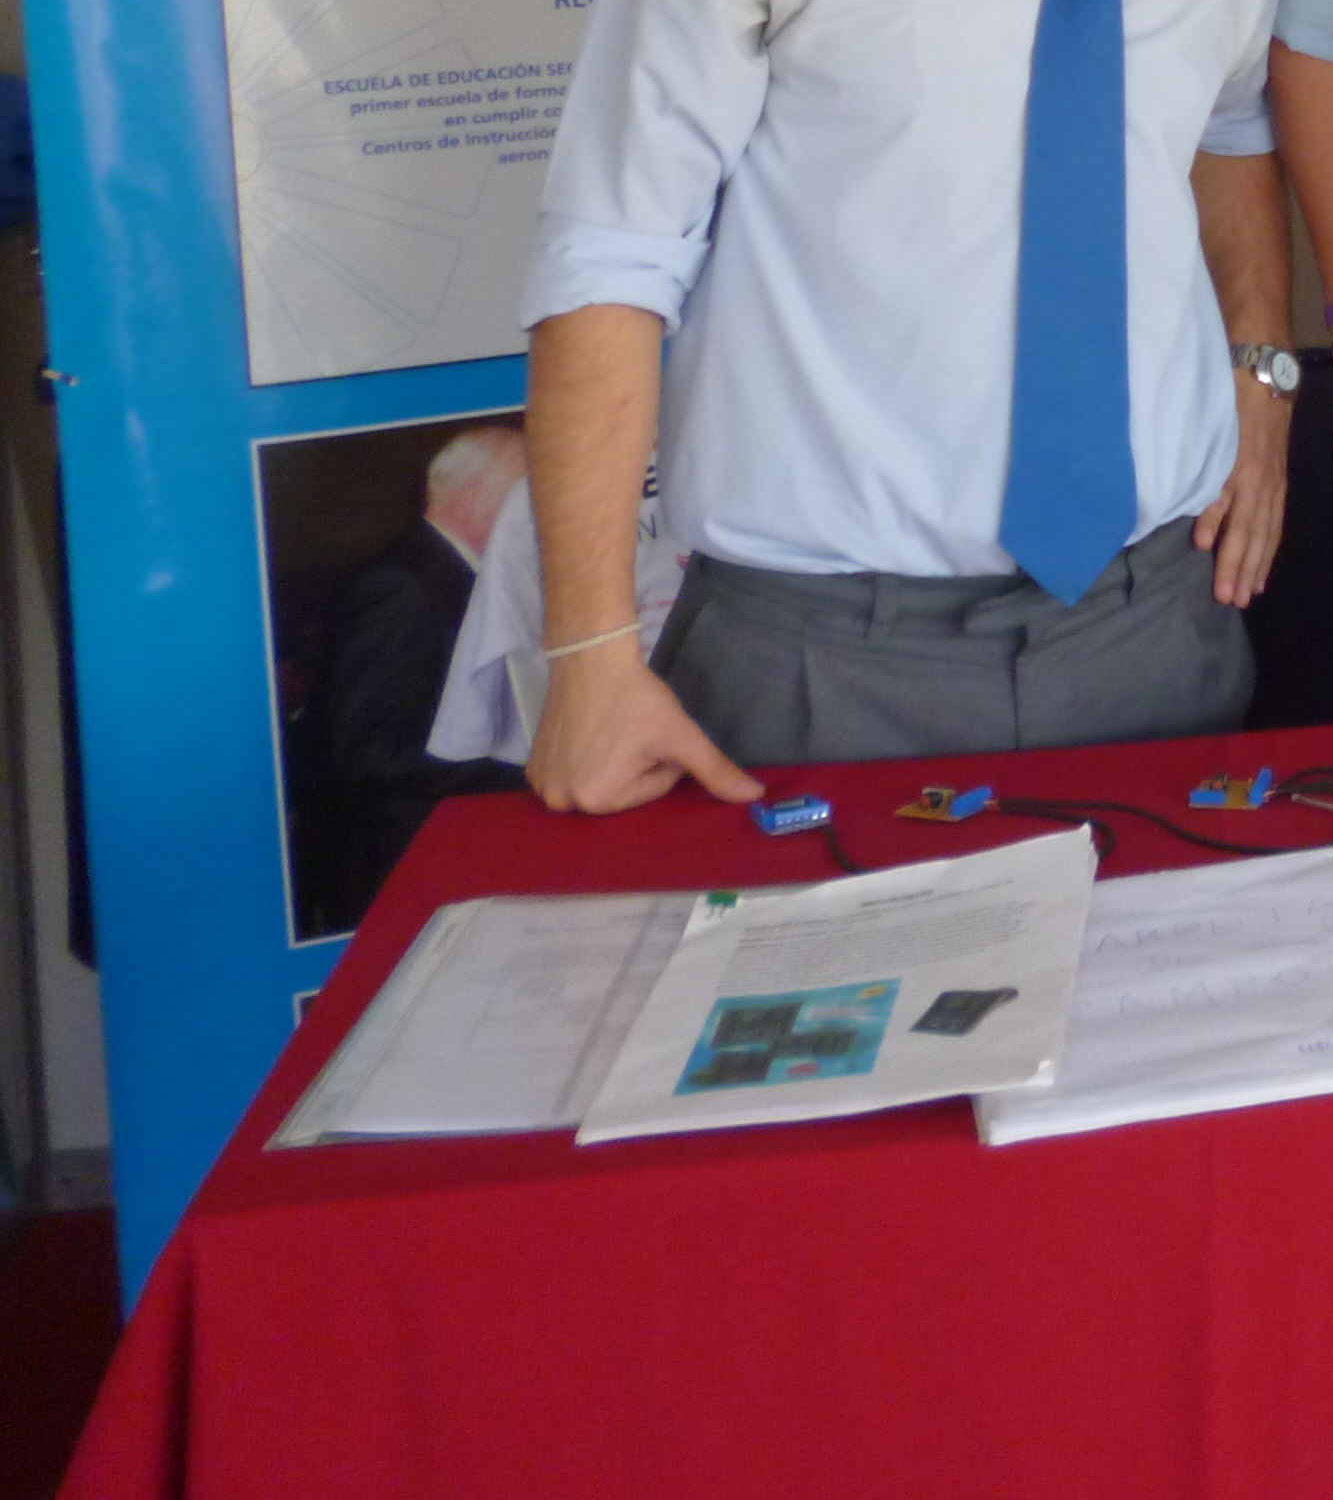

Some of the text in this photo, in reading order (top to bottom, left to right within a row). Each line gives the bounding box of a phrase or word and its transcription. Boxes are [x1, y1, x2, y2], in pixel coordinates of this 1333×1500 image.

[324, 63, 542, 95] ESCUELA DE EDUCACIÓN
[349, 97, 412, 117] primer
[415, 90, 483, 108] escuela
[486, 87, 510, 103] de
[444, 106, 539, 127] en cumplir
[361, 133, 460, 155] Centros de
